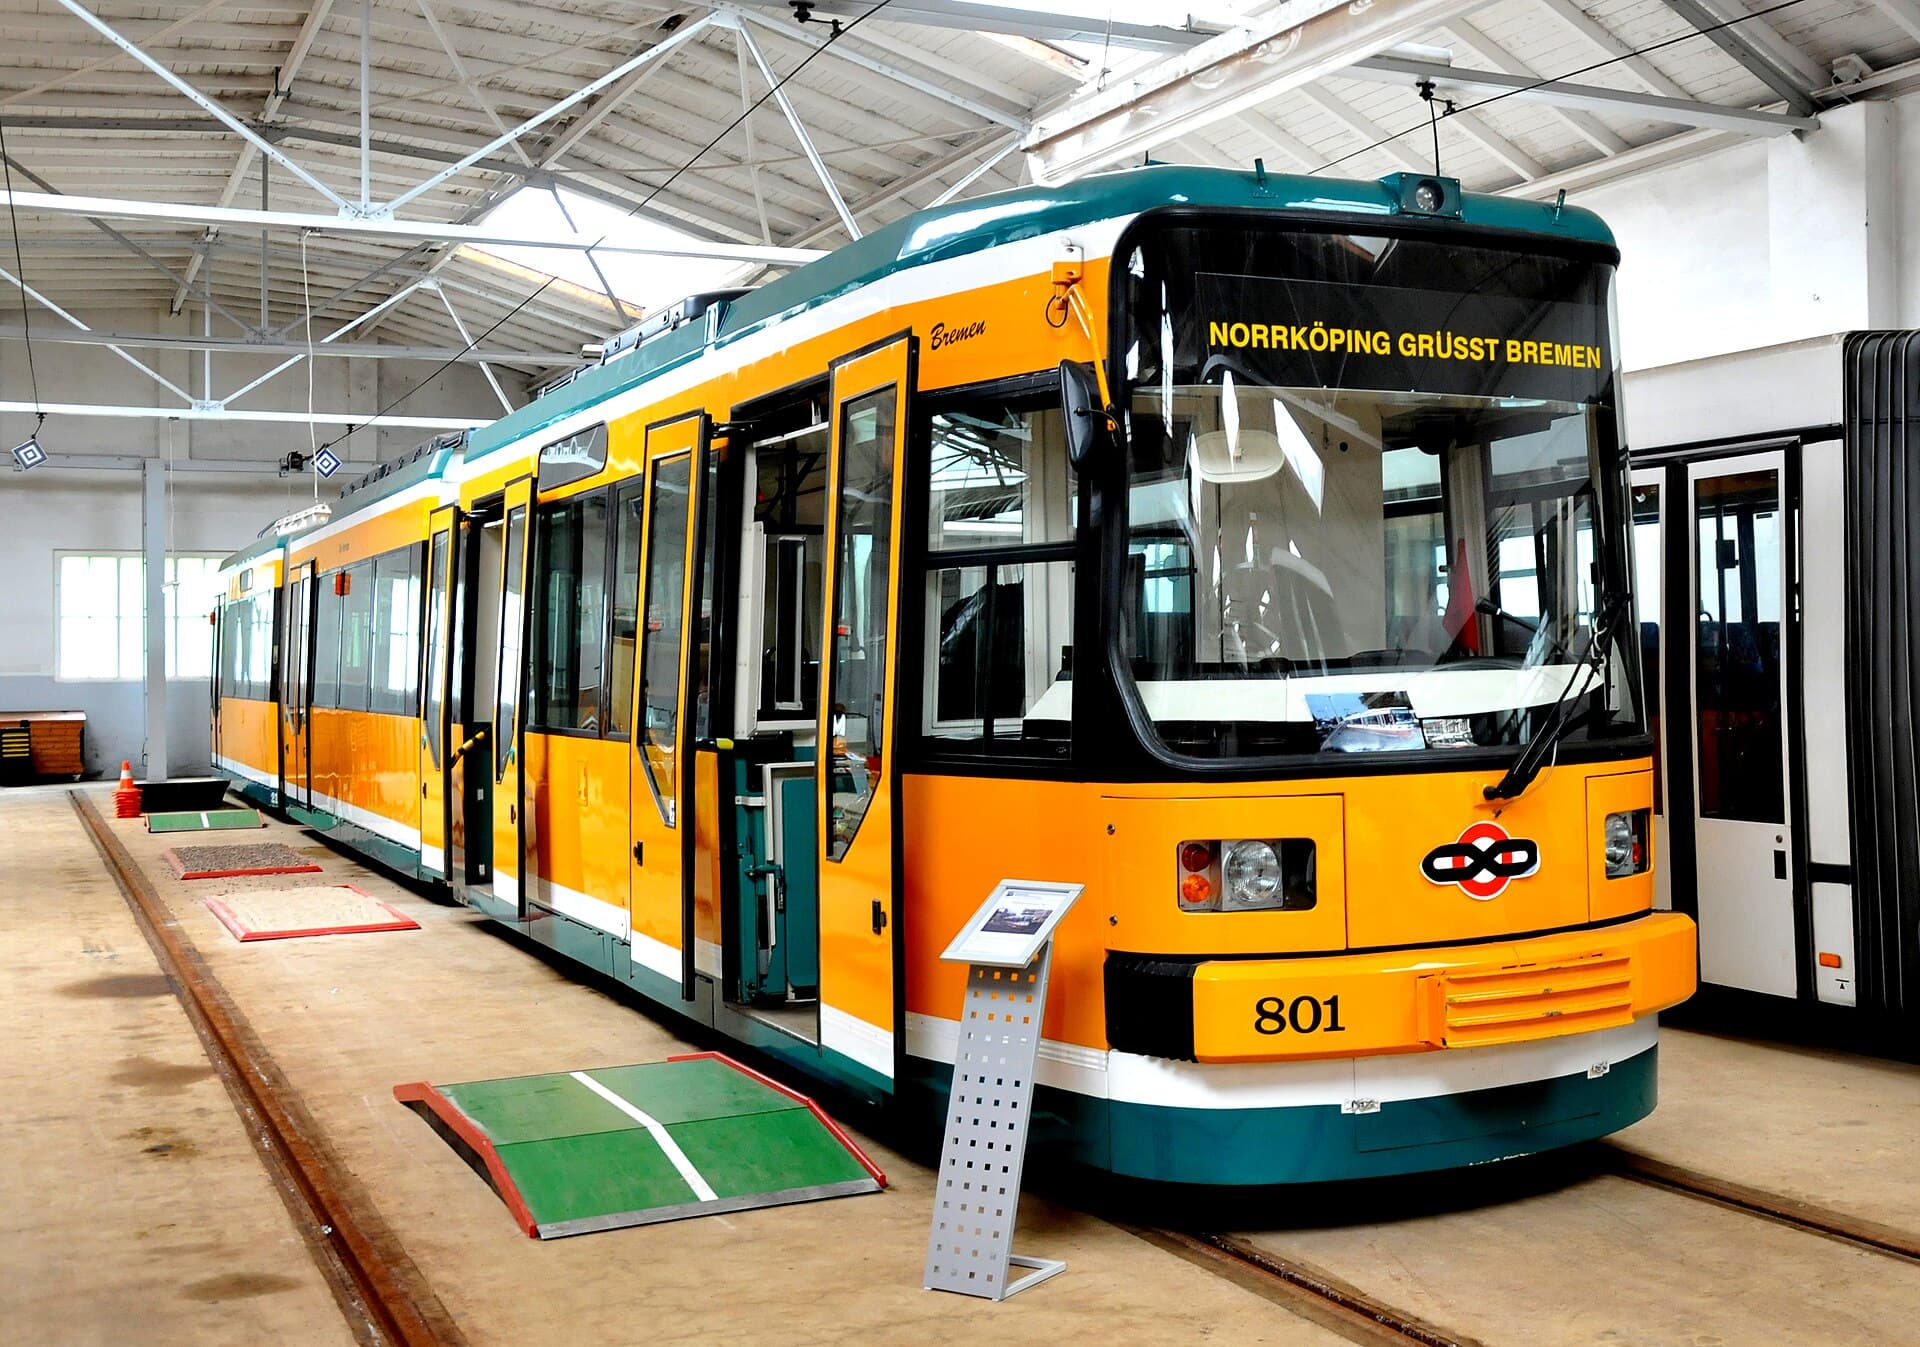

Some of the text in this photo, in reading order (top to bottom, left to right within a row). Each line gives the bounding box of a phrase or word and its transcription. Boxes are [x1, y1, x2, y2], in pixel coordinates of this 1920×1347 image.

[930, 320, 987, 351] Bremen
[1209, 321, 1602, 369] NORRKÖPING GRÜSST BREMEN
[1254, 994, 1346, 1035] 801
